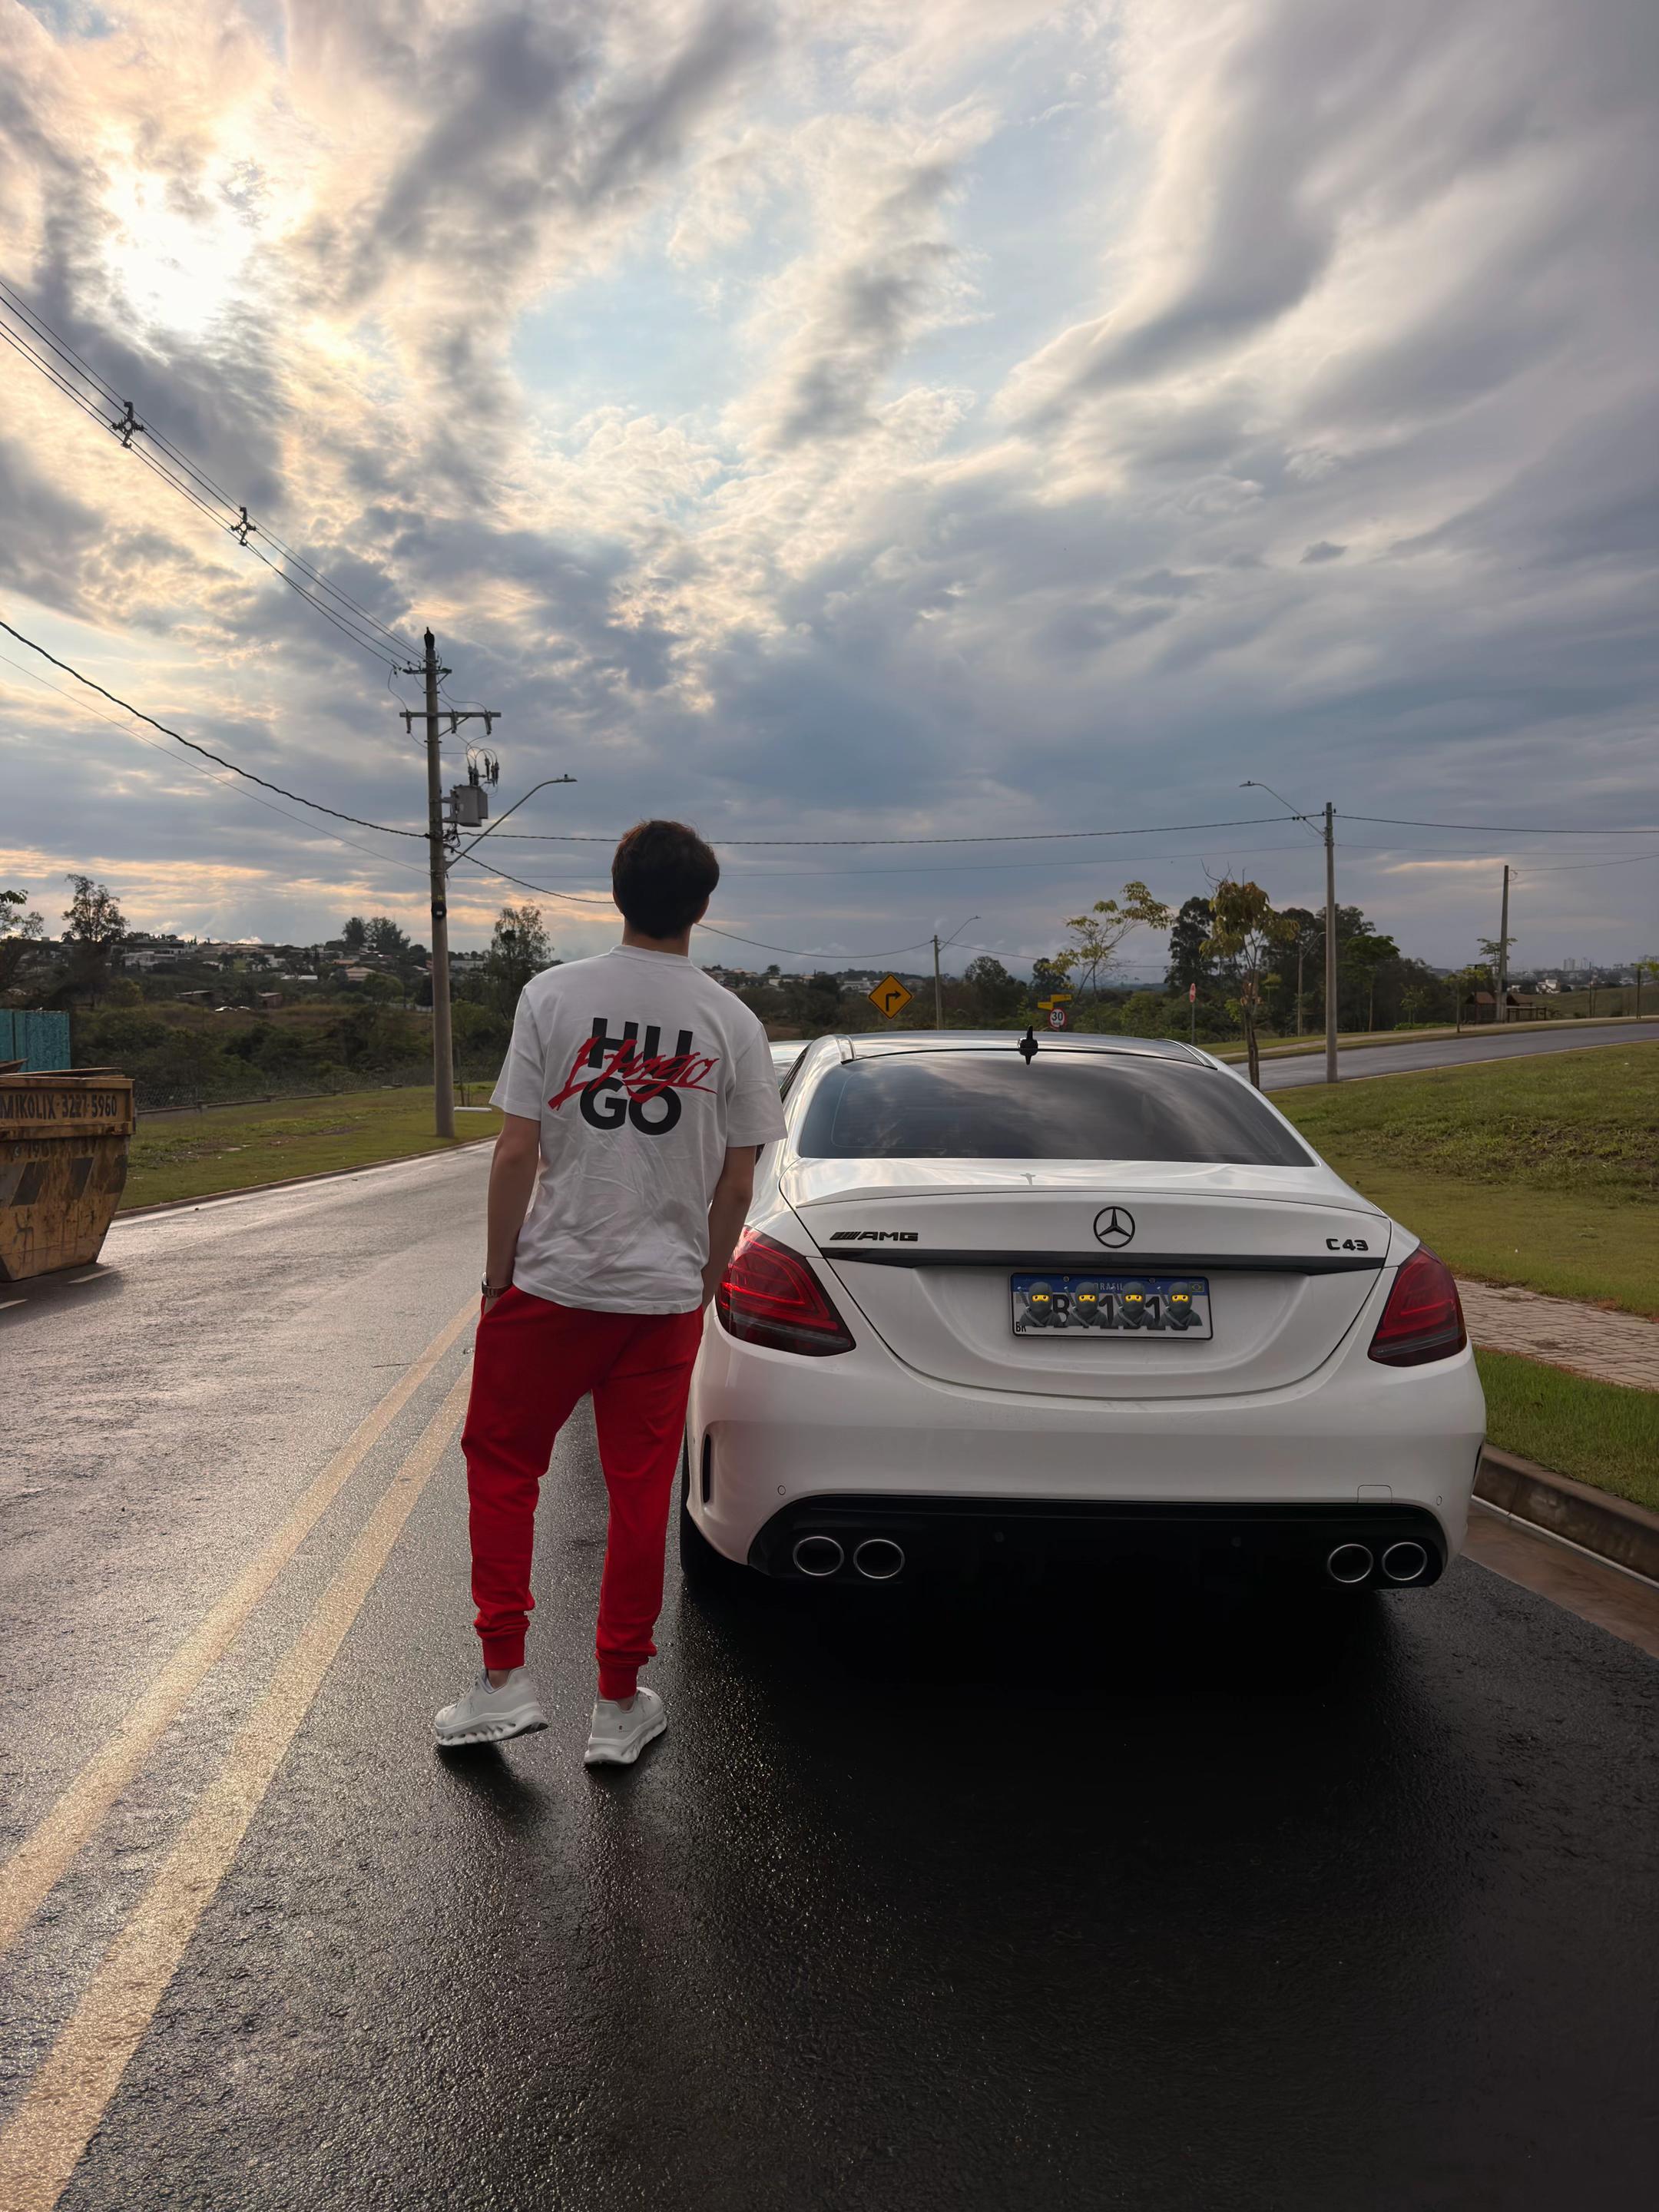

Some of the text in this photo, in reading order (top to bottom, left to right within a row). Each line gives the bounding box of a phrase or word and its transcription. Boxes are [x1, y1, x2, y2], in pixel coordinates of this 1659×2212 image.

[1051, 1012, 1063, 1021] 30
[548, 1037, 720, 1111] Hugo
[588, 1018, 693, 1079] HU
[580, 1076, 681, 1135] GO
[857, 1231, 918, 1241] AMG
